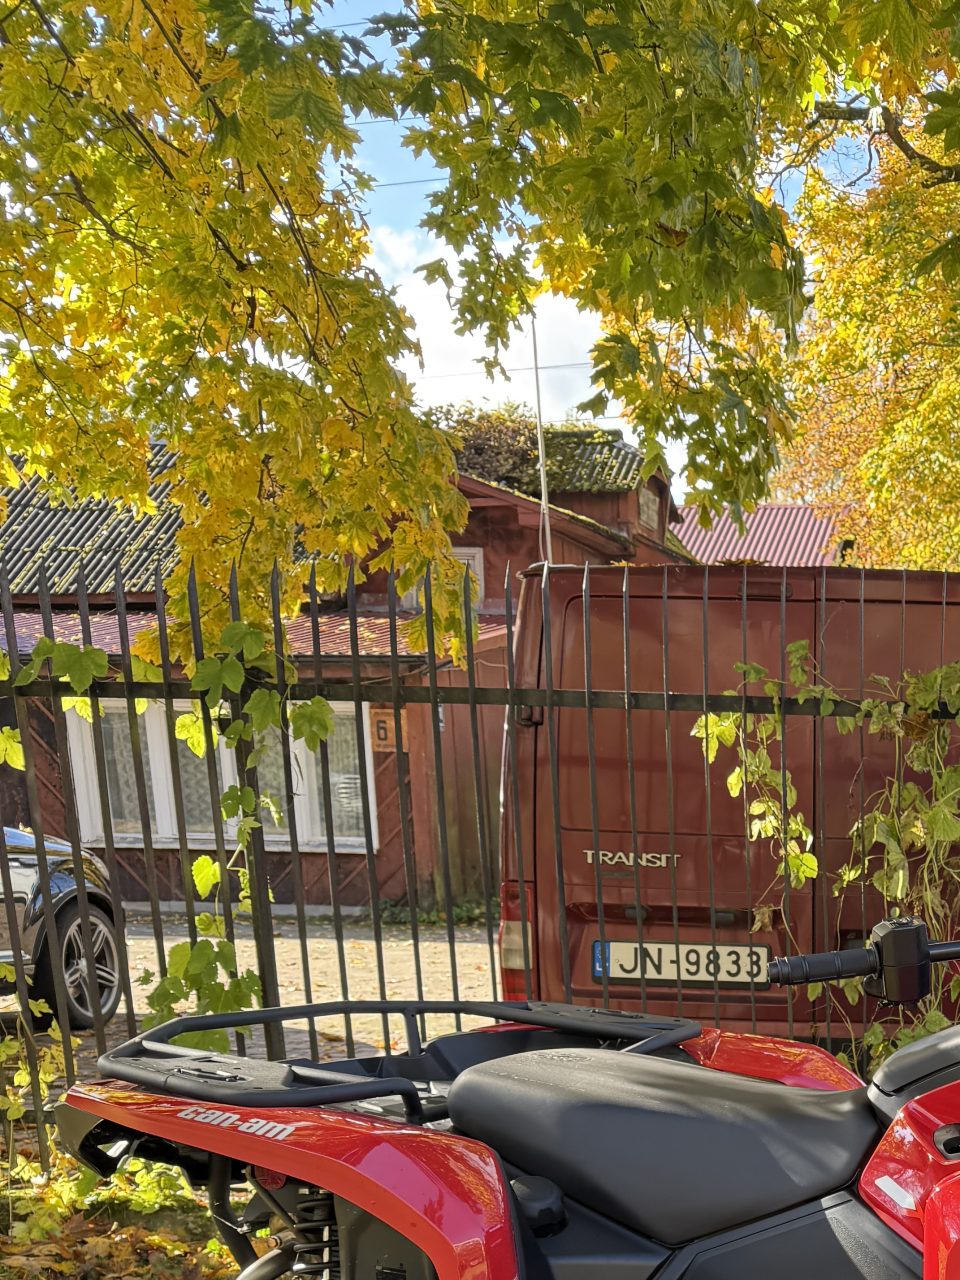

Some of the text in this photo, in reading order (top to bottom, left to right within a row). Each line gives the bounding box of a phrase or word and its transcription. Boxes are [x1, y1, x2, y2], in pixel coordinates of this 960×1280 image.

[376, 719, 388, 741] 6
[583, 850, 681, 868] TRANSIT
[618, 947, 762, 979] JN-9833
[176, 1106, 297, 1141] can-am
